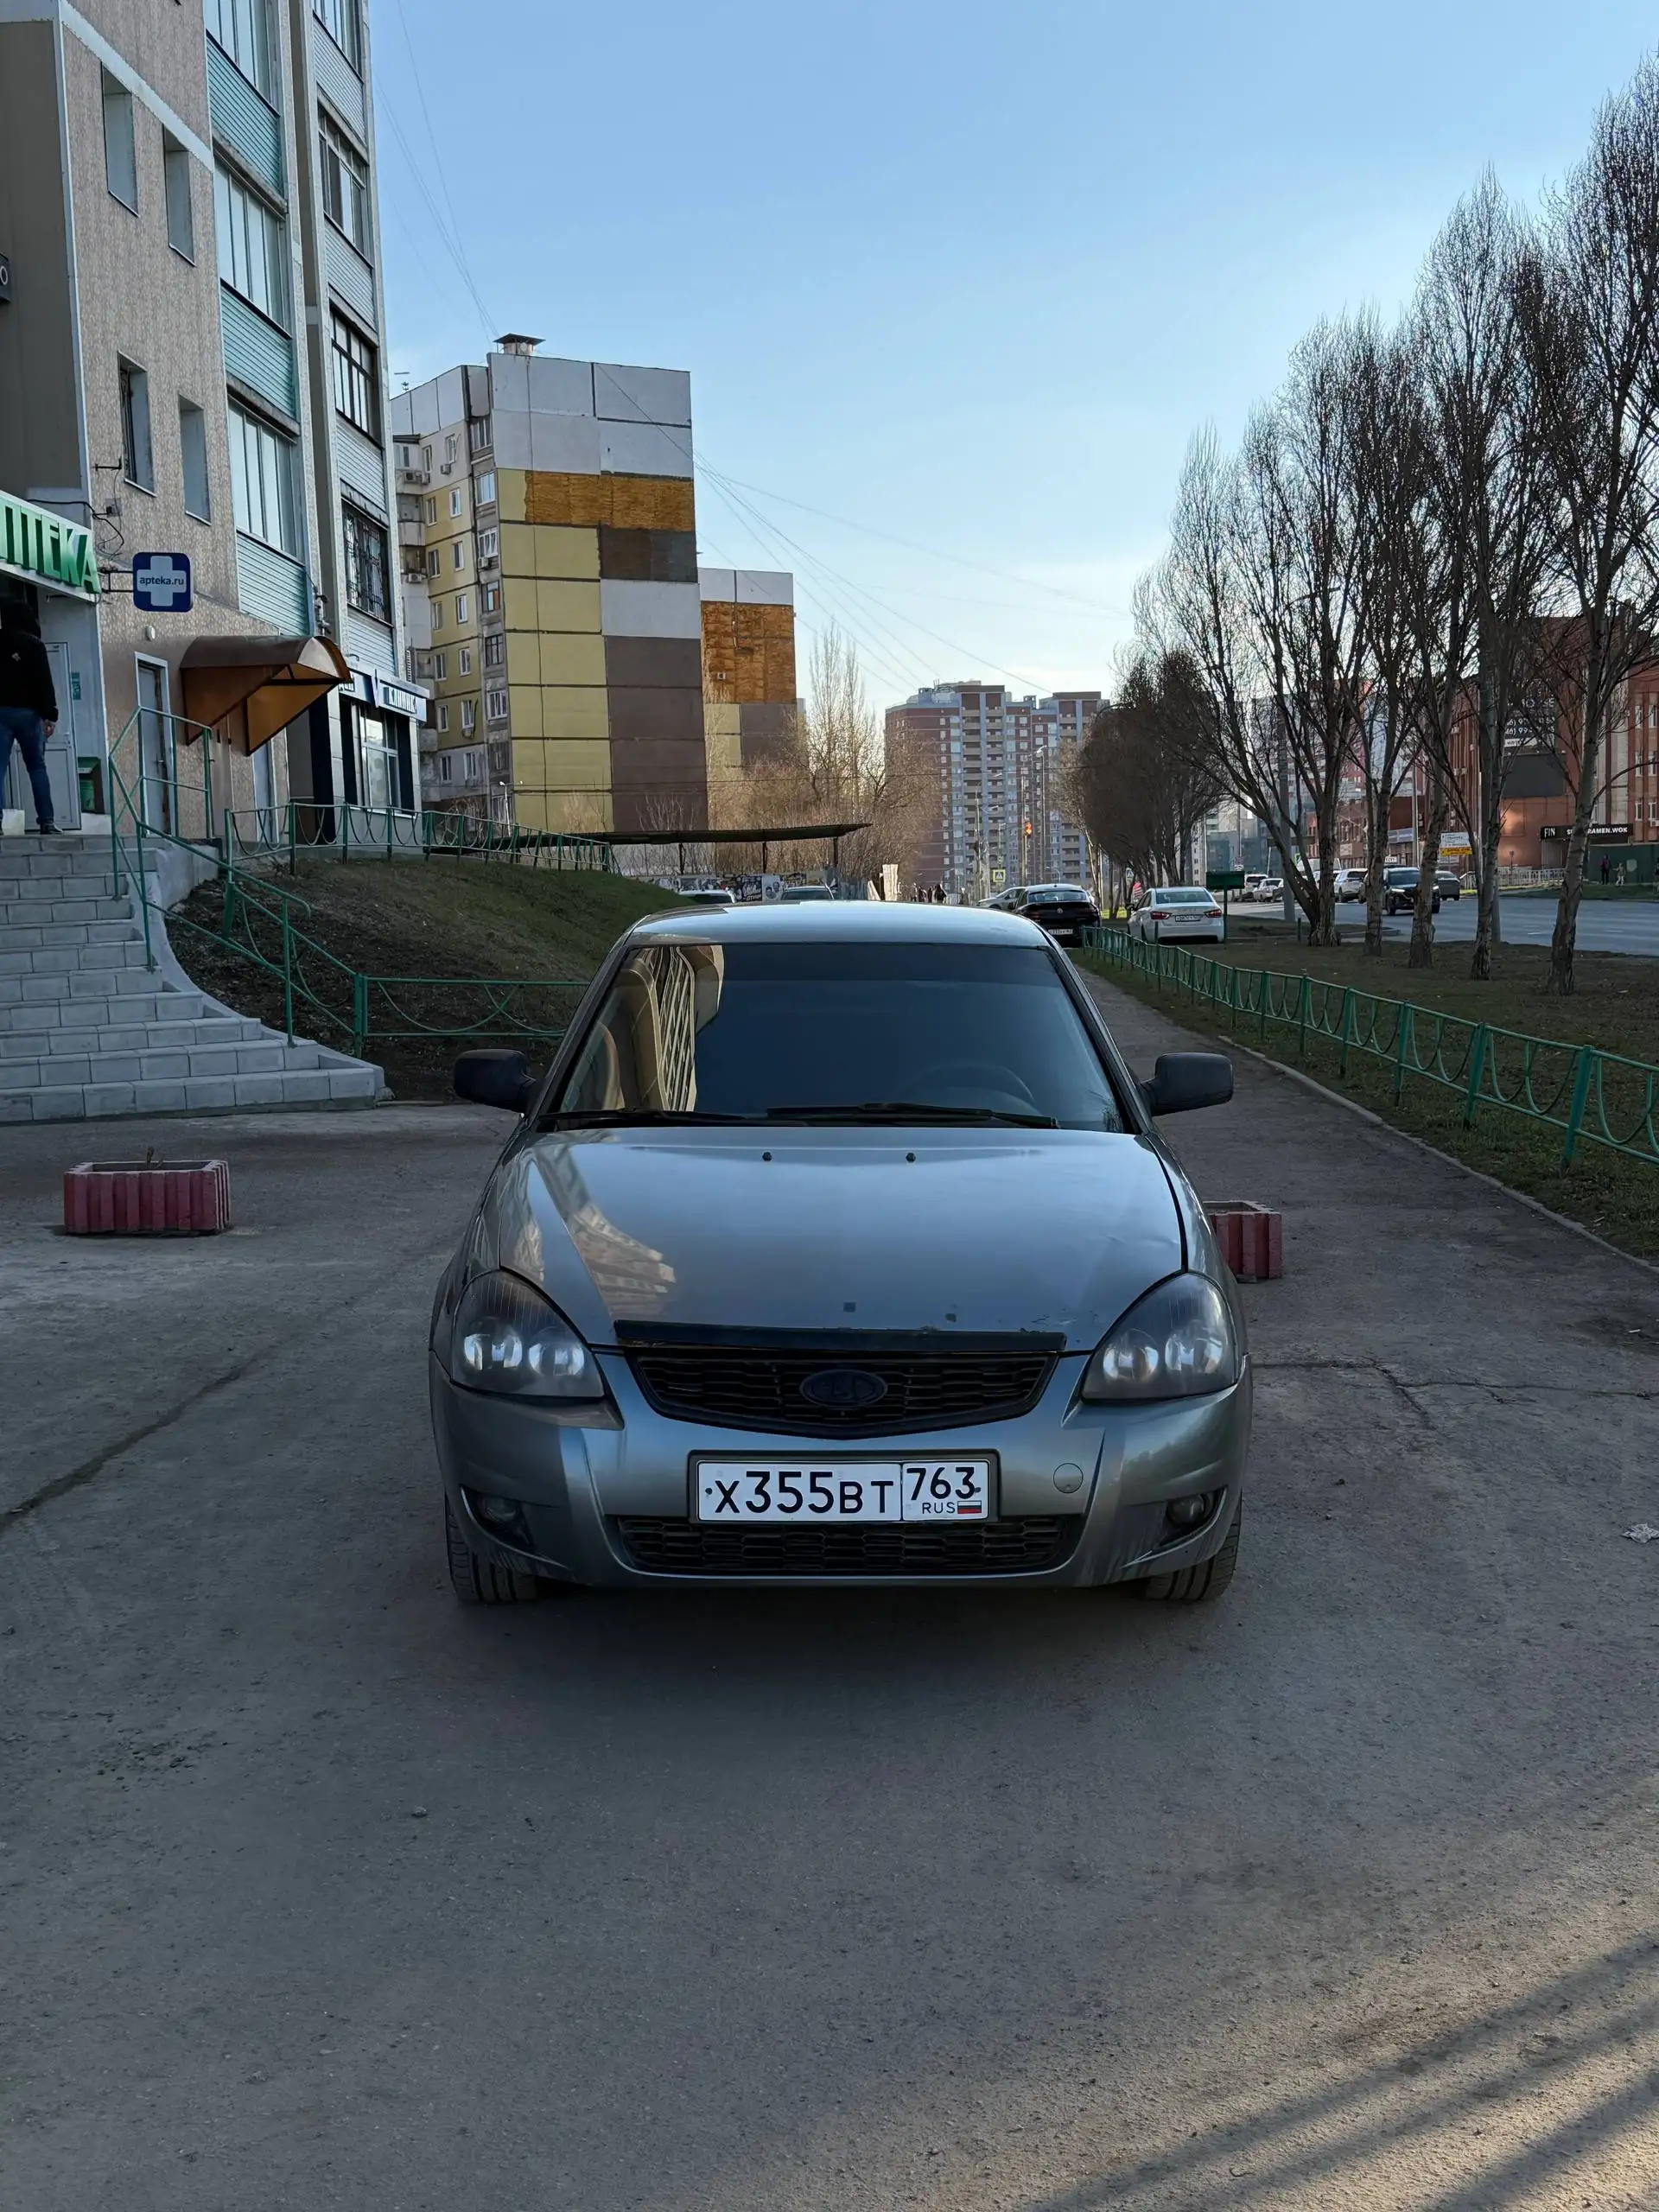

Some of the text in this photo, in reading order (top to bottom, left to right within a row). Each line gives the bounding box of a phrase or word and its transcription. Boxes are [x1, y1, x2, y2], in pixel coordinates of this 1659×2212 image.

[139, 575, 184, 586] apteka.ru
[1544, 828, 1556, 837] FIN
[715, 1466, 976, 1513] Х355ВТ 763
[922, 1502, 956, 1514] RUS
